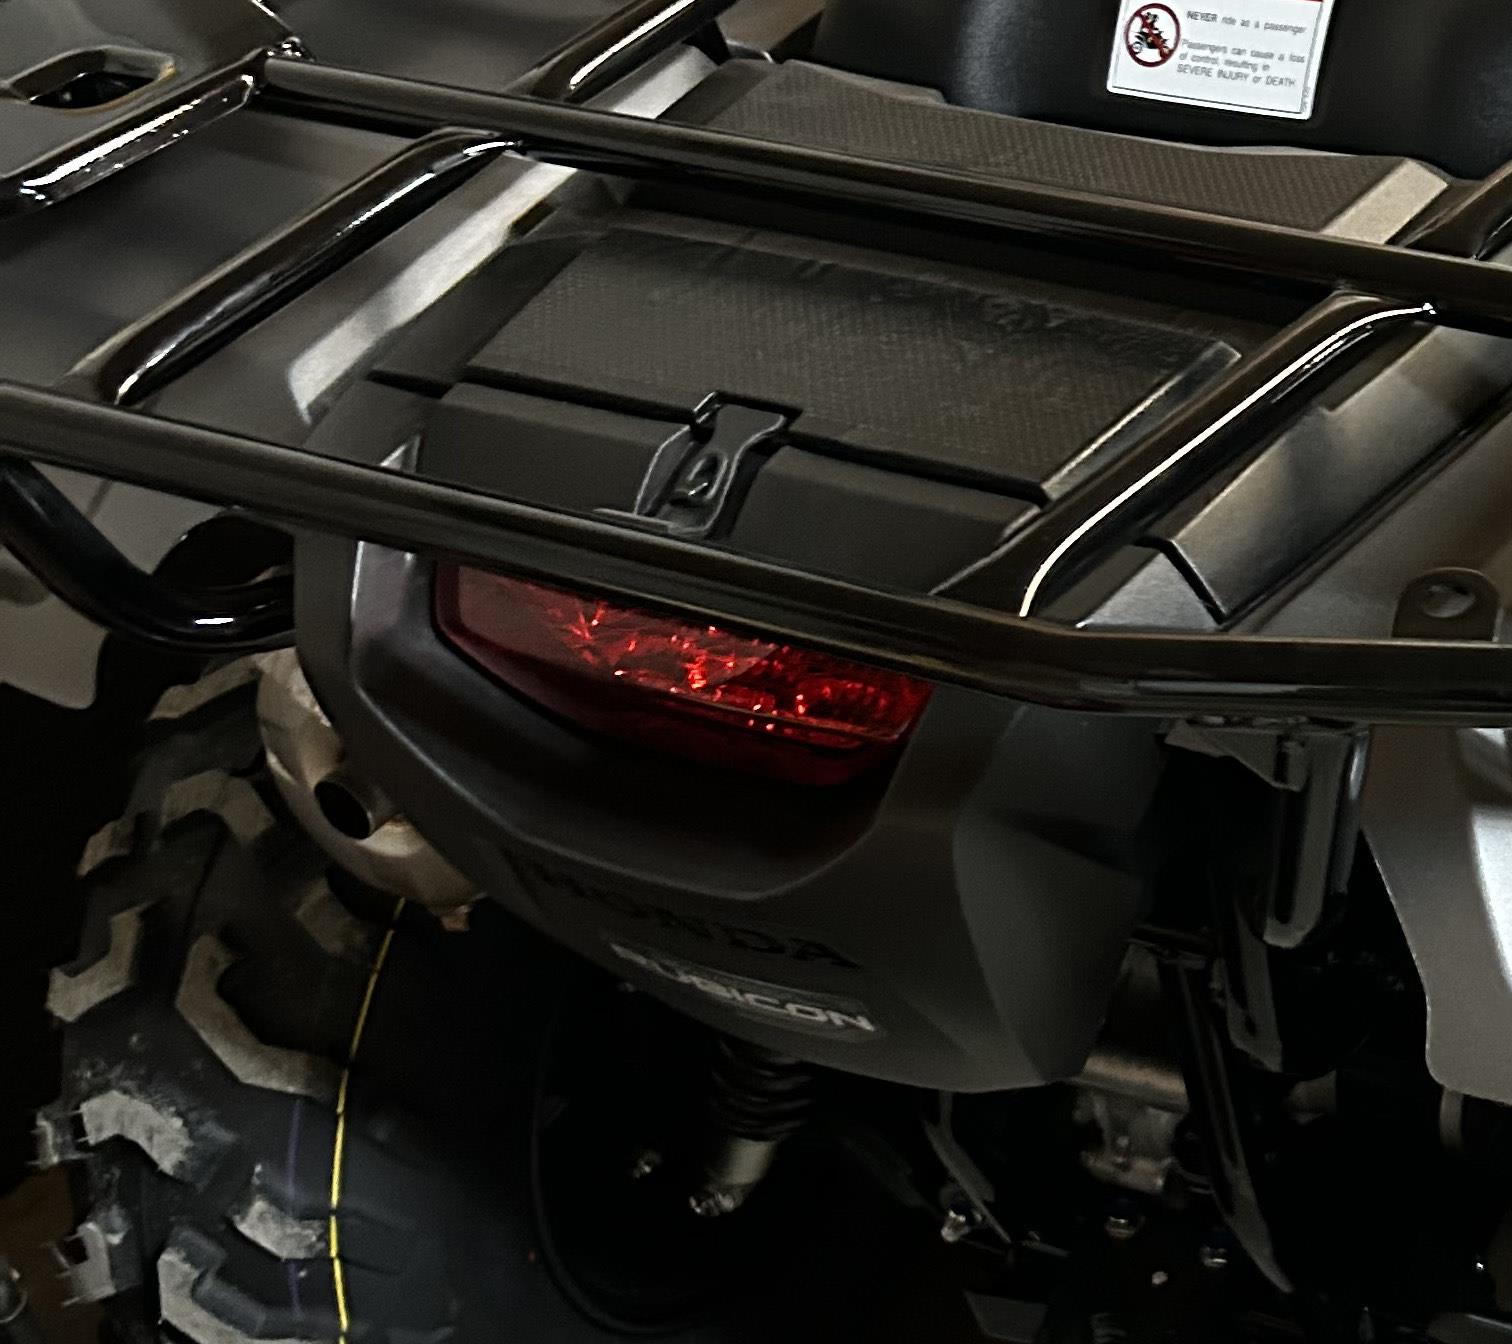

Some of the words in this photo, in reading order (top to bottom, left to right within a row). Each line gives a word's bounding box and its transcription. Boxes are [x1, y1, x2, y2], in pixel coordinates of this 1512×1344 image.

[1176, 63, 1214, 78] SEVERE
[1216, 69, 1249, 81] INJURY
[1265, 75, 1296, 87] DEATH
